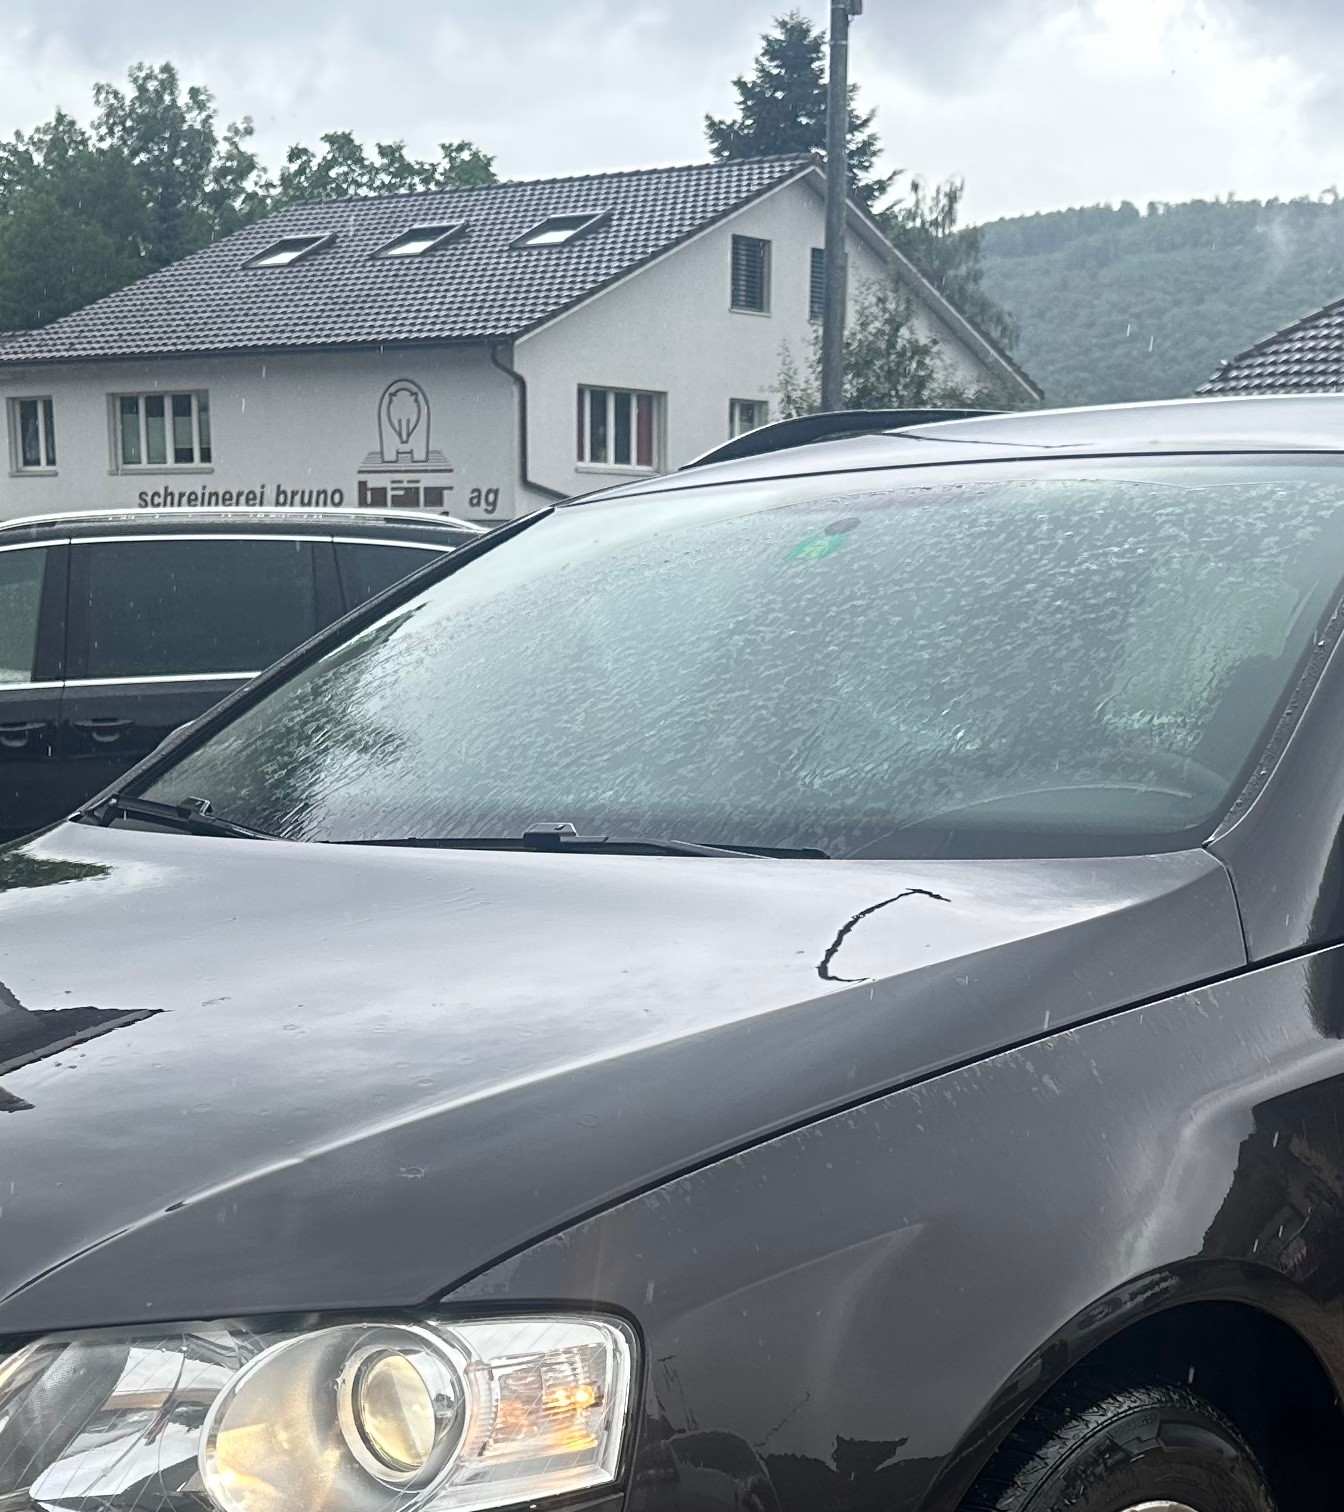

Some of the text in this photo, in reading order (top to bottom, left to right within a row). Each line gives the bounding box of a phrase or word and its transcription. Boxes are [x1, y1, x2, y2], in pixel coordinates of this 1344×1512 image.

[138, 484, 266, 509] schreinerei
[274, 484, 345, 508] bruno
[469, 487, 500, 515] ag
